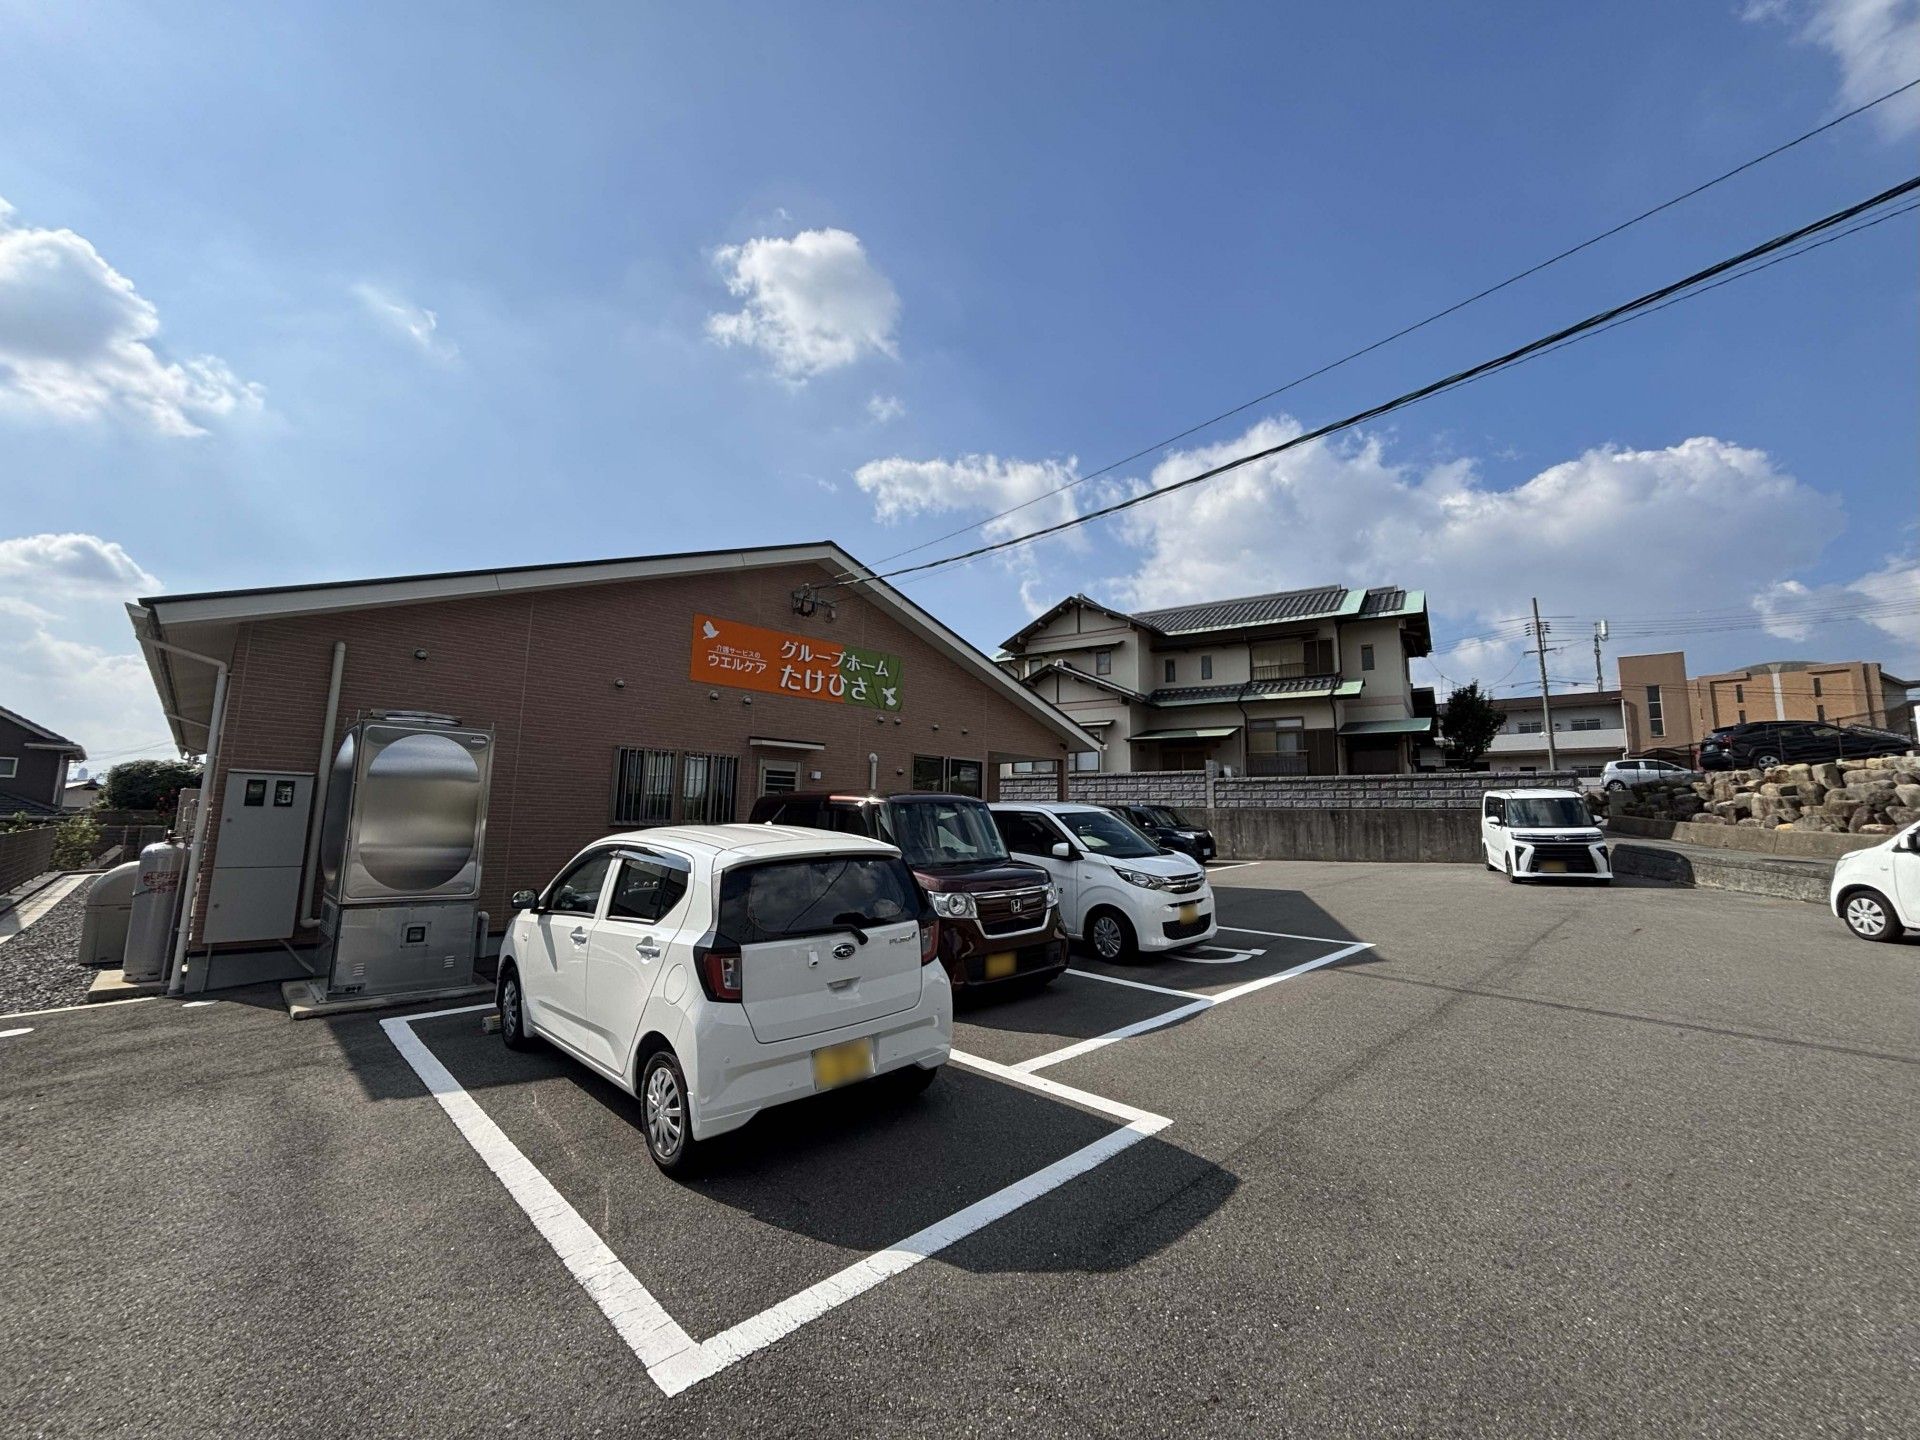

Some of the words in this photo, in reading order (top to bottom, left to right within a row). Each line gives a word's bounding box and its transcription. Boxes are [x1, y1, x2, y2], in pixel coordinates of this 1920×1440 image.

[708, 654, 767, 674] ウエルケア
[781, 641, 889, 677] グループホーム
[780, 664, 868, 700] たけひさ
